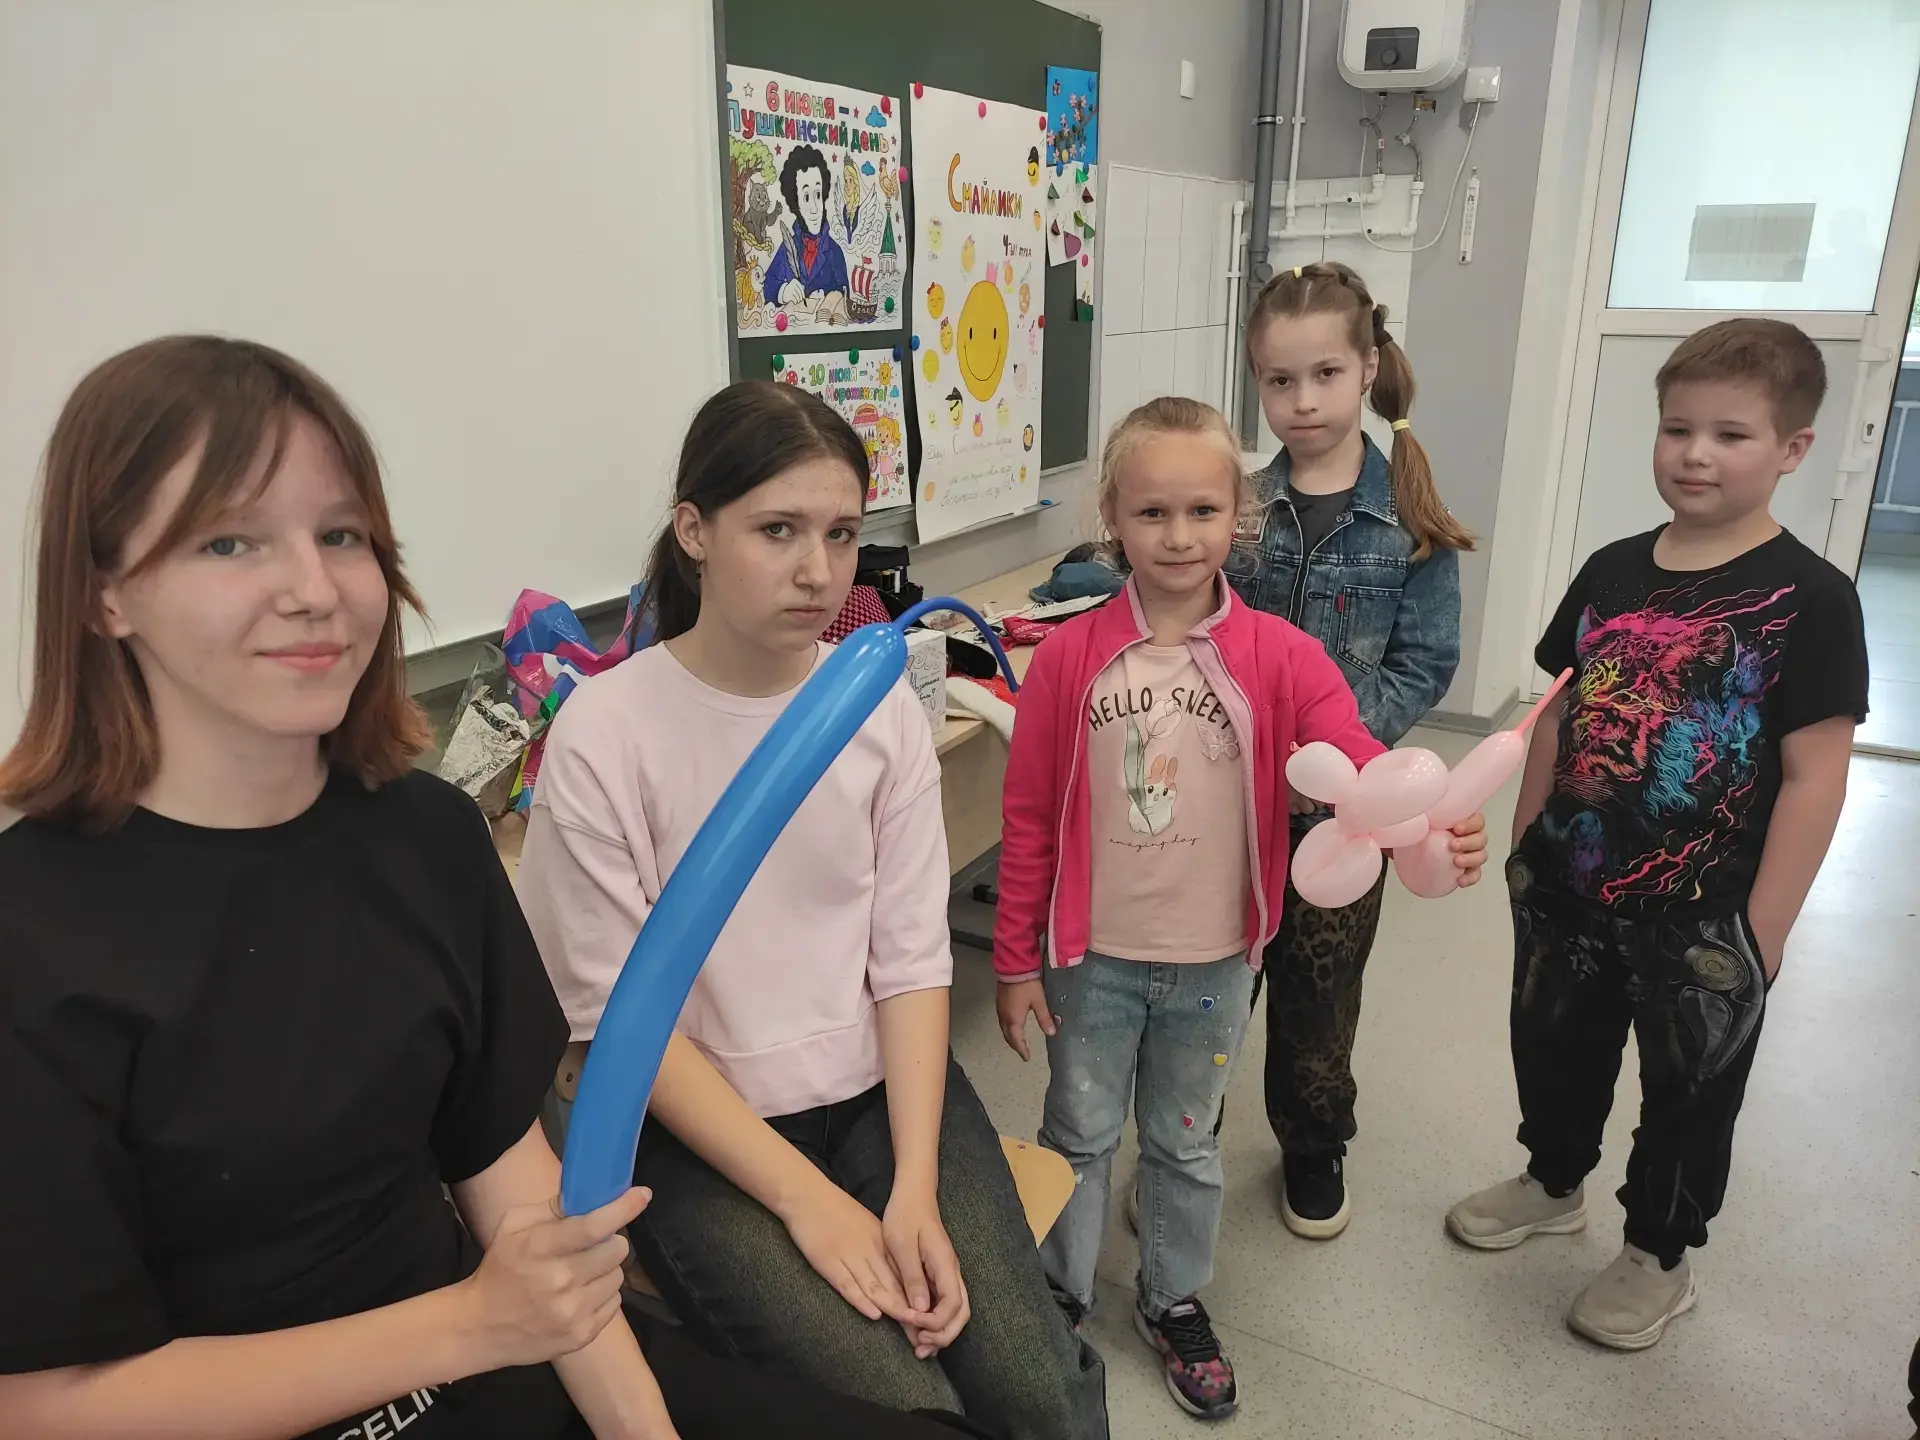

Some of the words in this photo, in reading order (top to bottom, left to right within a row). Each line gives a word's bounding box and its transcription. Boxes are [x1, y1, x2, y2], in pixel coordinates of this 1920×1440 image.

[766, 81, 780, 112] 6
[809, 363, 825, 386] 10
[1089, 687, 1152, 731] HELLO
[1171, 833, 1200, 846] day
